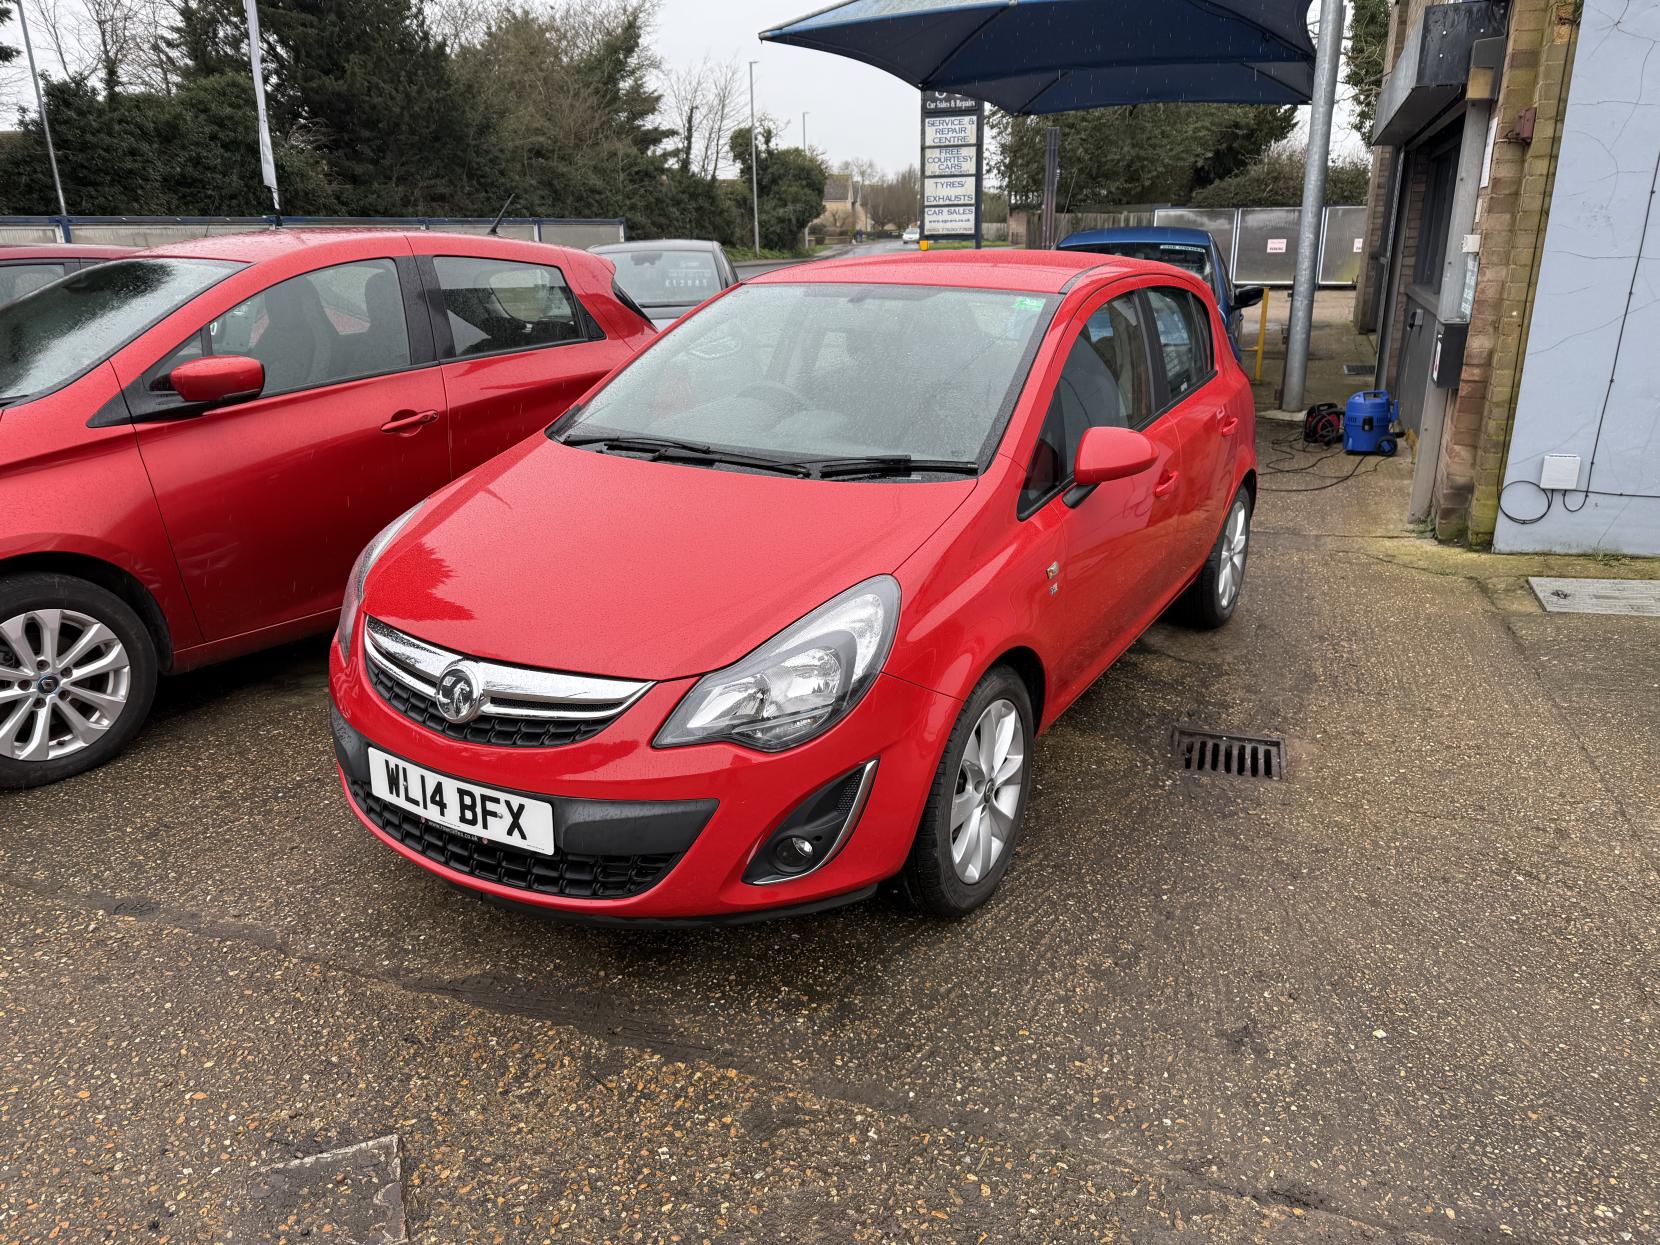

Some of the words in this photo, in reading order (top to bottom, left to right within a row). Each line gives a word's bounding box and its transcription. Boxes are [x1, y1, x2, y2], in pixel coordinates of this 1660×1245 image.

[926, 100, 936, 109] Car
[936, 99, 950, 108] Sales
[950, 99, 956, 108] &
[956, 98, 976, 109] Repairs
[927, 118, 965, 128] SERVICE
[968, 117, 975, 126] &
[934, 126, 967, 136] REPAIR
[932, 135, 970, 144] CENTRE
[939, 148, 962, 156] FREE
[926, 155, 974, 164] COURTESY
[937, 162, 962, 171] CARS
[926, 194, 974, 203] EXHAUSTS
[947, 208, 974, 216] SALES
[384, 758, 448, 818] WL14
[456, 786, 528, 841] BFX
